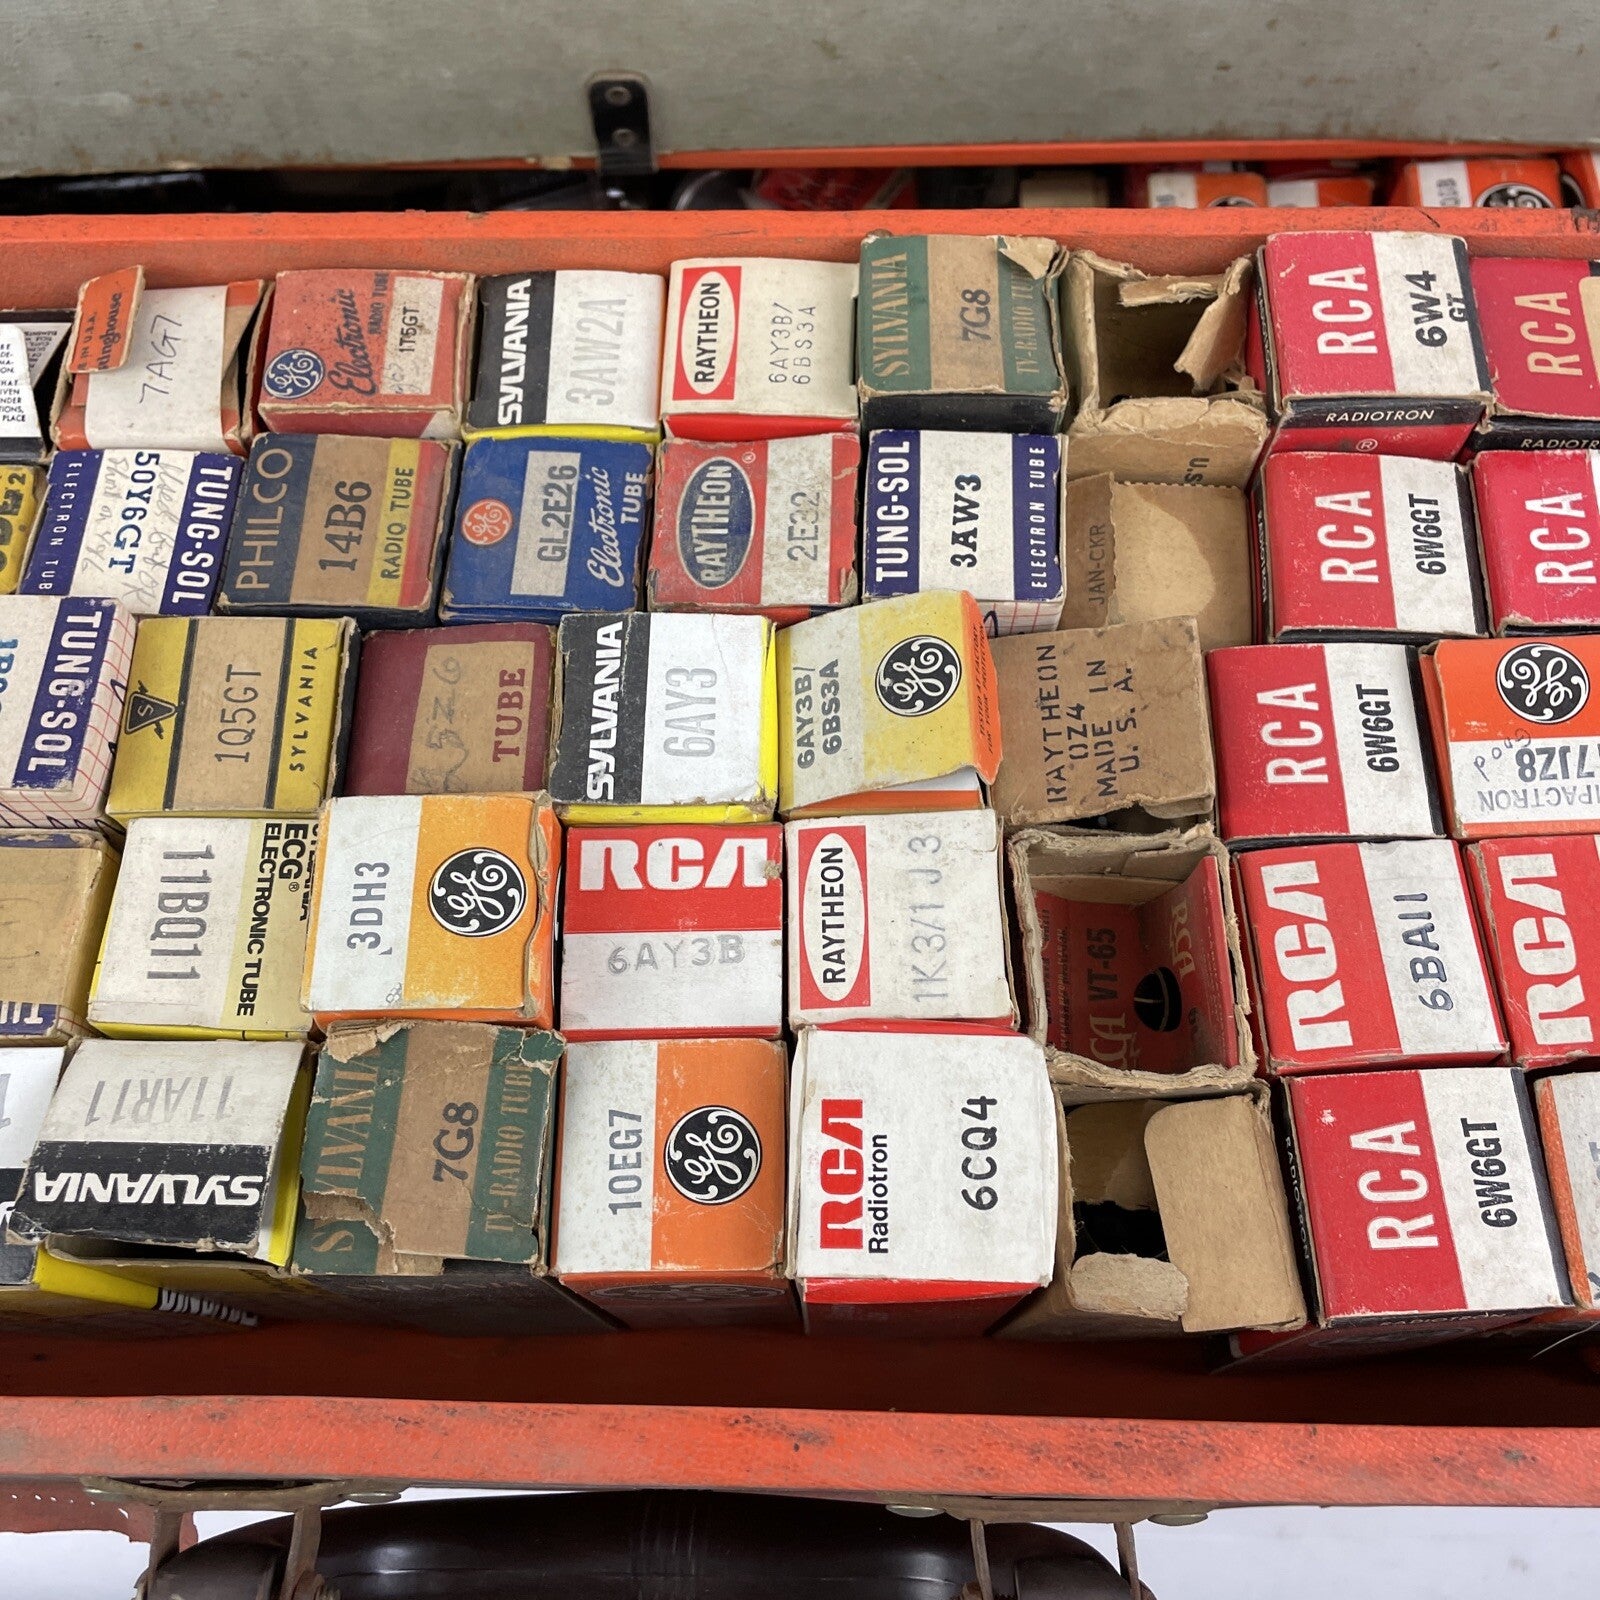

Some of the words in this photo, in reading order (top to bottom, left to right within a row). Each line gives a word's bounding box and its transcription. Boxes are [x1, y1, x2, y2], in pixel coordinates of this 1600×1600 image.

[327, 288, 378, 397] Electronic
[399, 306, 421, 353] 1T5GT
[498, 279, 532, 426] SYLVANIA
[565, 299, 627, 406] 3AW2A
[694, 282, 721, 383] RAYTHEON
[768, 302, 794, 384] 6AY3B/
[792, 306, 817, 385] 6BS3A
[872, 252, 910, 378] SYLVANIA
[959, 289, 991, 341] 7G8
[1308, 264, 1379, 355] RCA
[1405, 270, 1448, 347] 6W4
[1449, 293, 1468, 322] GT
[1514, 291, 1585, 377] RCA
[3, 414, 26, 422] PLACE
[1325, 410, 1435, 423] RADIOTRON
[1521, 437, 1600, 450] RADIOTR
[50, 462, 83, 546] ELECTRON
[108, 451, 161, 574] 50Y6GT
[390, 467, 415, 512] TUBE
[620, 471, 643, 525] TUBE
[875, 441, 910, 582] TUNG-SOL
[1028, 447, 1046, 488] TUBE
[1184, 457, 1210, 485] U.S
[171, 466, 233, 604] TUNG-SOL
[235, 448, 293, 589] PHILCO
[318, 480, 372, 571] 14B6
[380, 522, 406, 579] RADIO
[537, 465, 578, 562] GL2E26
[587, 466, 625, 588] Electronic
[690, 465, 732, 582] RAYTHEON
[787, 491, 820, 562] 2E32
[950, 474, 982, 568] 3AW3
[1028, 501, 1047, 588] ELECTRON
[1314, 490, 1379, 584] RCA
[1408, 493, 1447, 576] 6W6GT
[1524, 492, 1598, 584] RCA
[38, 559, 59, 590] TUB
[1088, 524, 1106, 605] JAN-CKR
[27, 610, 103, 772] TUNG-SOL
[214, 664, 262, 763] 1Q5GT
[289, 647, 318, 772] SYLVANIA
[492, 668, 526, 763] TUBE
[586, 621, 623, 800] SYLVANIA
[663, 667, 718, 757] 6AY3
[818, 658, 842, 755] 6BS3A
[1086, 660, 1109, 693] IN
[1036, 644, 1068, 802] RAYTHEON
[1091, 720, 1118, 797] MADE
[1256, 683, 1329, 784] RCA
[1356, 684, 1400, 772] 6W6GT
[1514, 743, 1600, 783] 7JZ8
[1477, 784, 1600, 813] PACTRON
[247, 822, 283, 955] ELECTRONIC
[278, 823, 309, 880] ECG
[580, 838, 769, 891] RCA
[147, 844, 216, 979] 11BQ11
[347, 862, 390, 949] 3DH3
[821, 847, 846, 984] RAYTHEON
[1498, 853, 1594, 1045] RCA
[237, 958, 262, 1016] TUBE
[607, 934, 746, 975] 6AY3B
[1086, 928, 1119, 1003] VT-65
[1260, 860, 1353, 1051] RCA
[85, 1075, 234, 1127] 11AR11
[432, 1102, 479, 1182] 7G8
[35, 1172, 264, 1206] SYLVANIA
[311, 1050, 380, 1252] SLVANI
[608, 1109, 642, 1215] 10EG7
[820, 1099, 864, 1249] RCA
[868, 1134, 889, 1254] Radiotron
[961, 1096, 998, 1211] 6CQ4
[1350, 1120, 1439, 1250] RCA
[1460, 1117, 1518, 1229] 6W6GT
